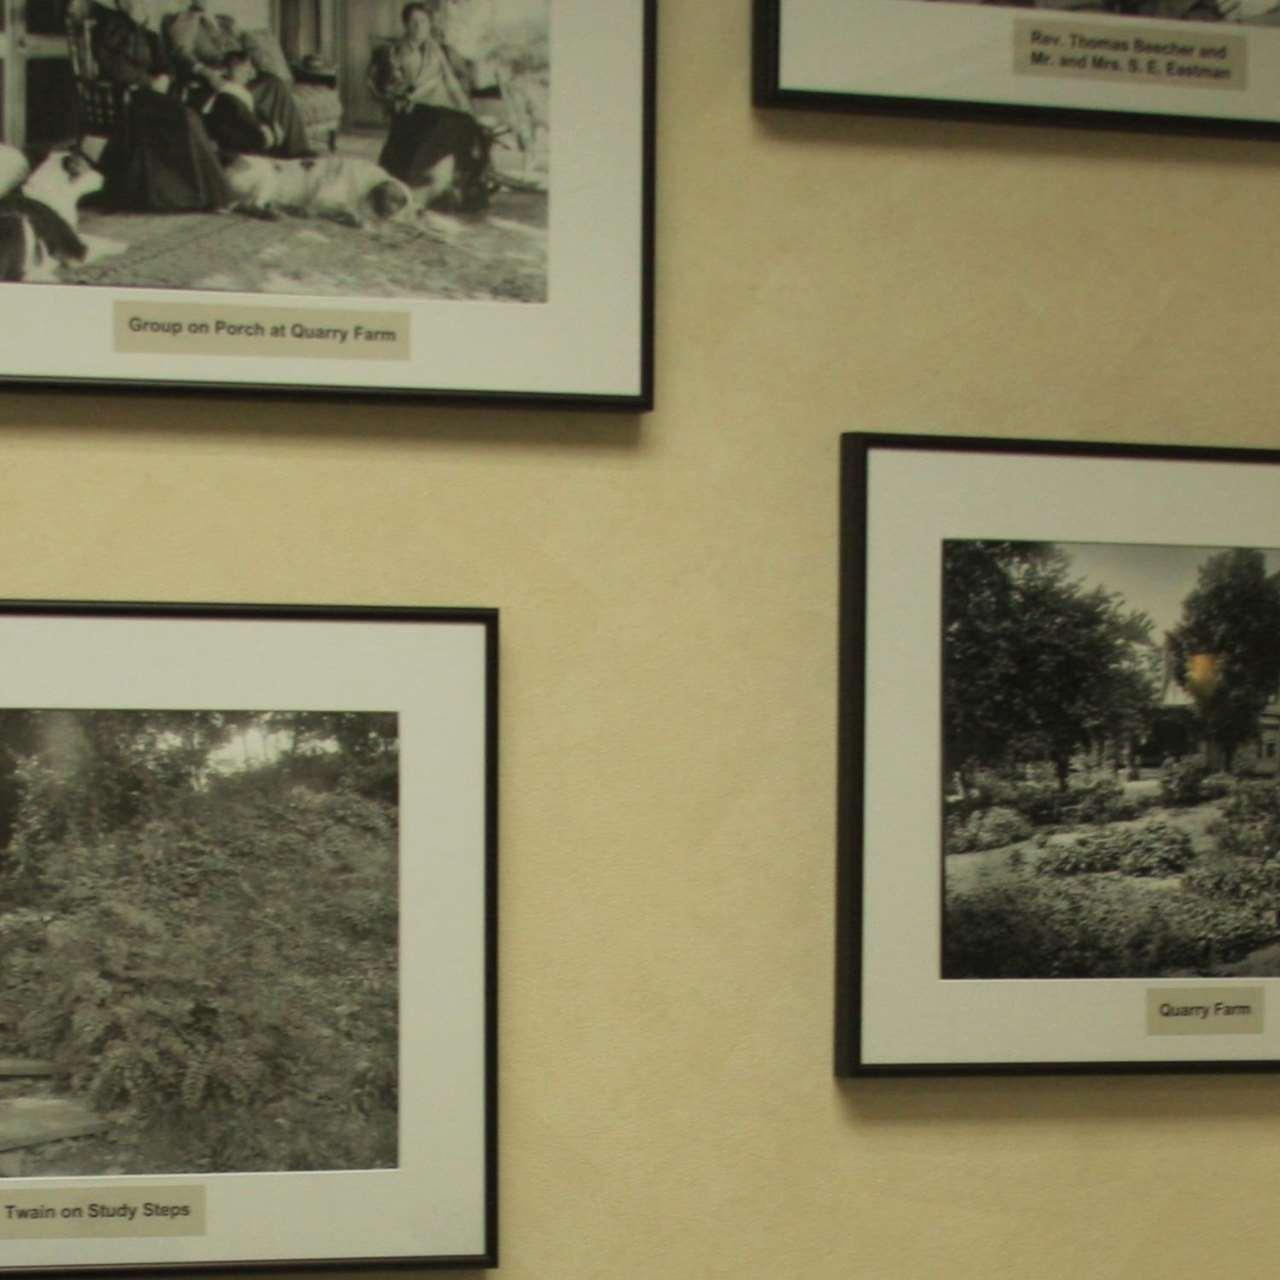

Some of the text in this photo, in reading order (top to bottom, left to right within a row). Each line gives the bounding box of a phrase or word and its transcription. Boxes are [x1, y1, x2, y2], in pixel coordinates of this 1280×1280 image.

[1030, 31, 1228, 59] Rev. Thomas Beecher and
[1030, 51, 1054, 66] Mr.
[1059, 54, 1087, 69] and
[1091, 56, 1123, 71] Mrs.
[1147, 60, 1161, 75] E.
[1166, 62, 1232, 79] Eastman
[127, 316, 397, 344] Group on Porch at Quarry Farm
[1159, 1002, 1252, 1020] Quarry Farm
[4, 1202, 191, 1221] Twain on Study Steps
